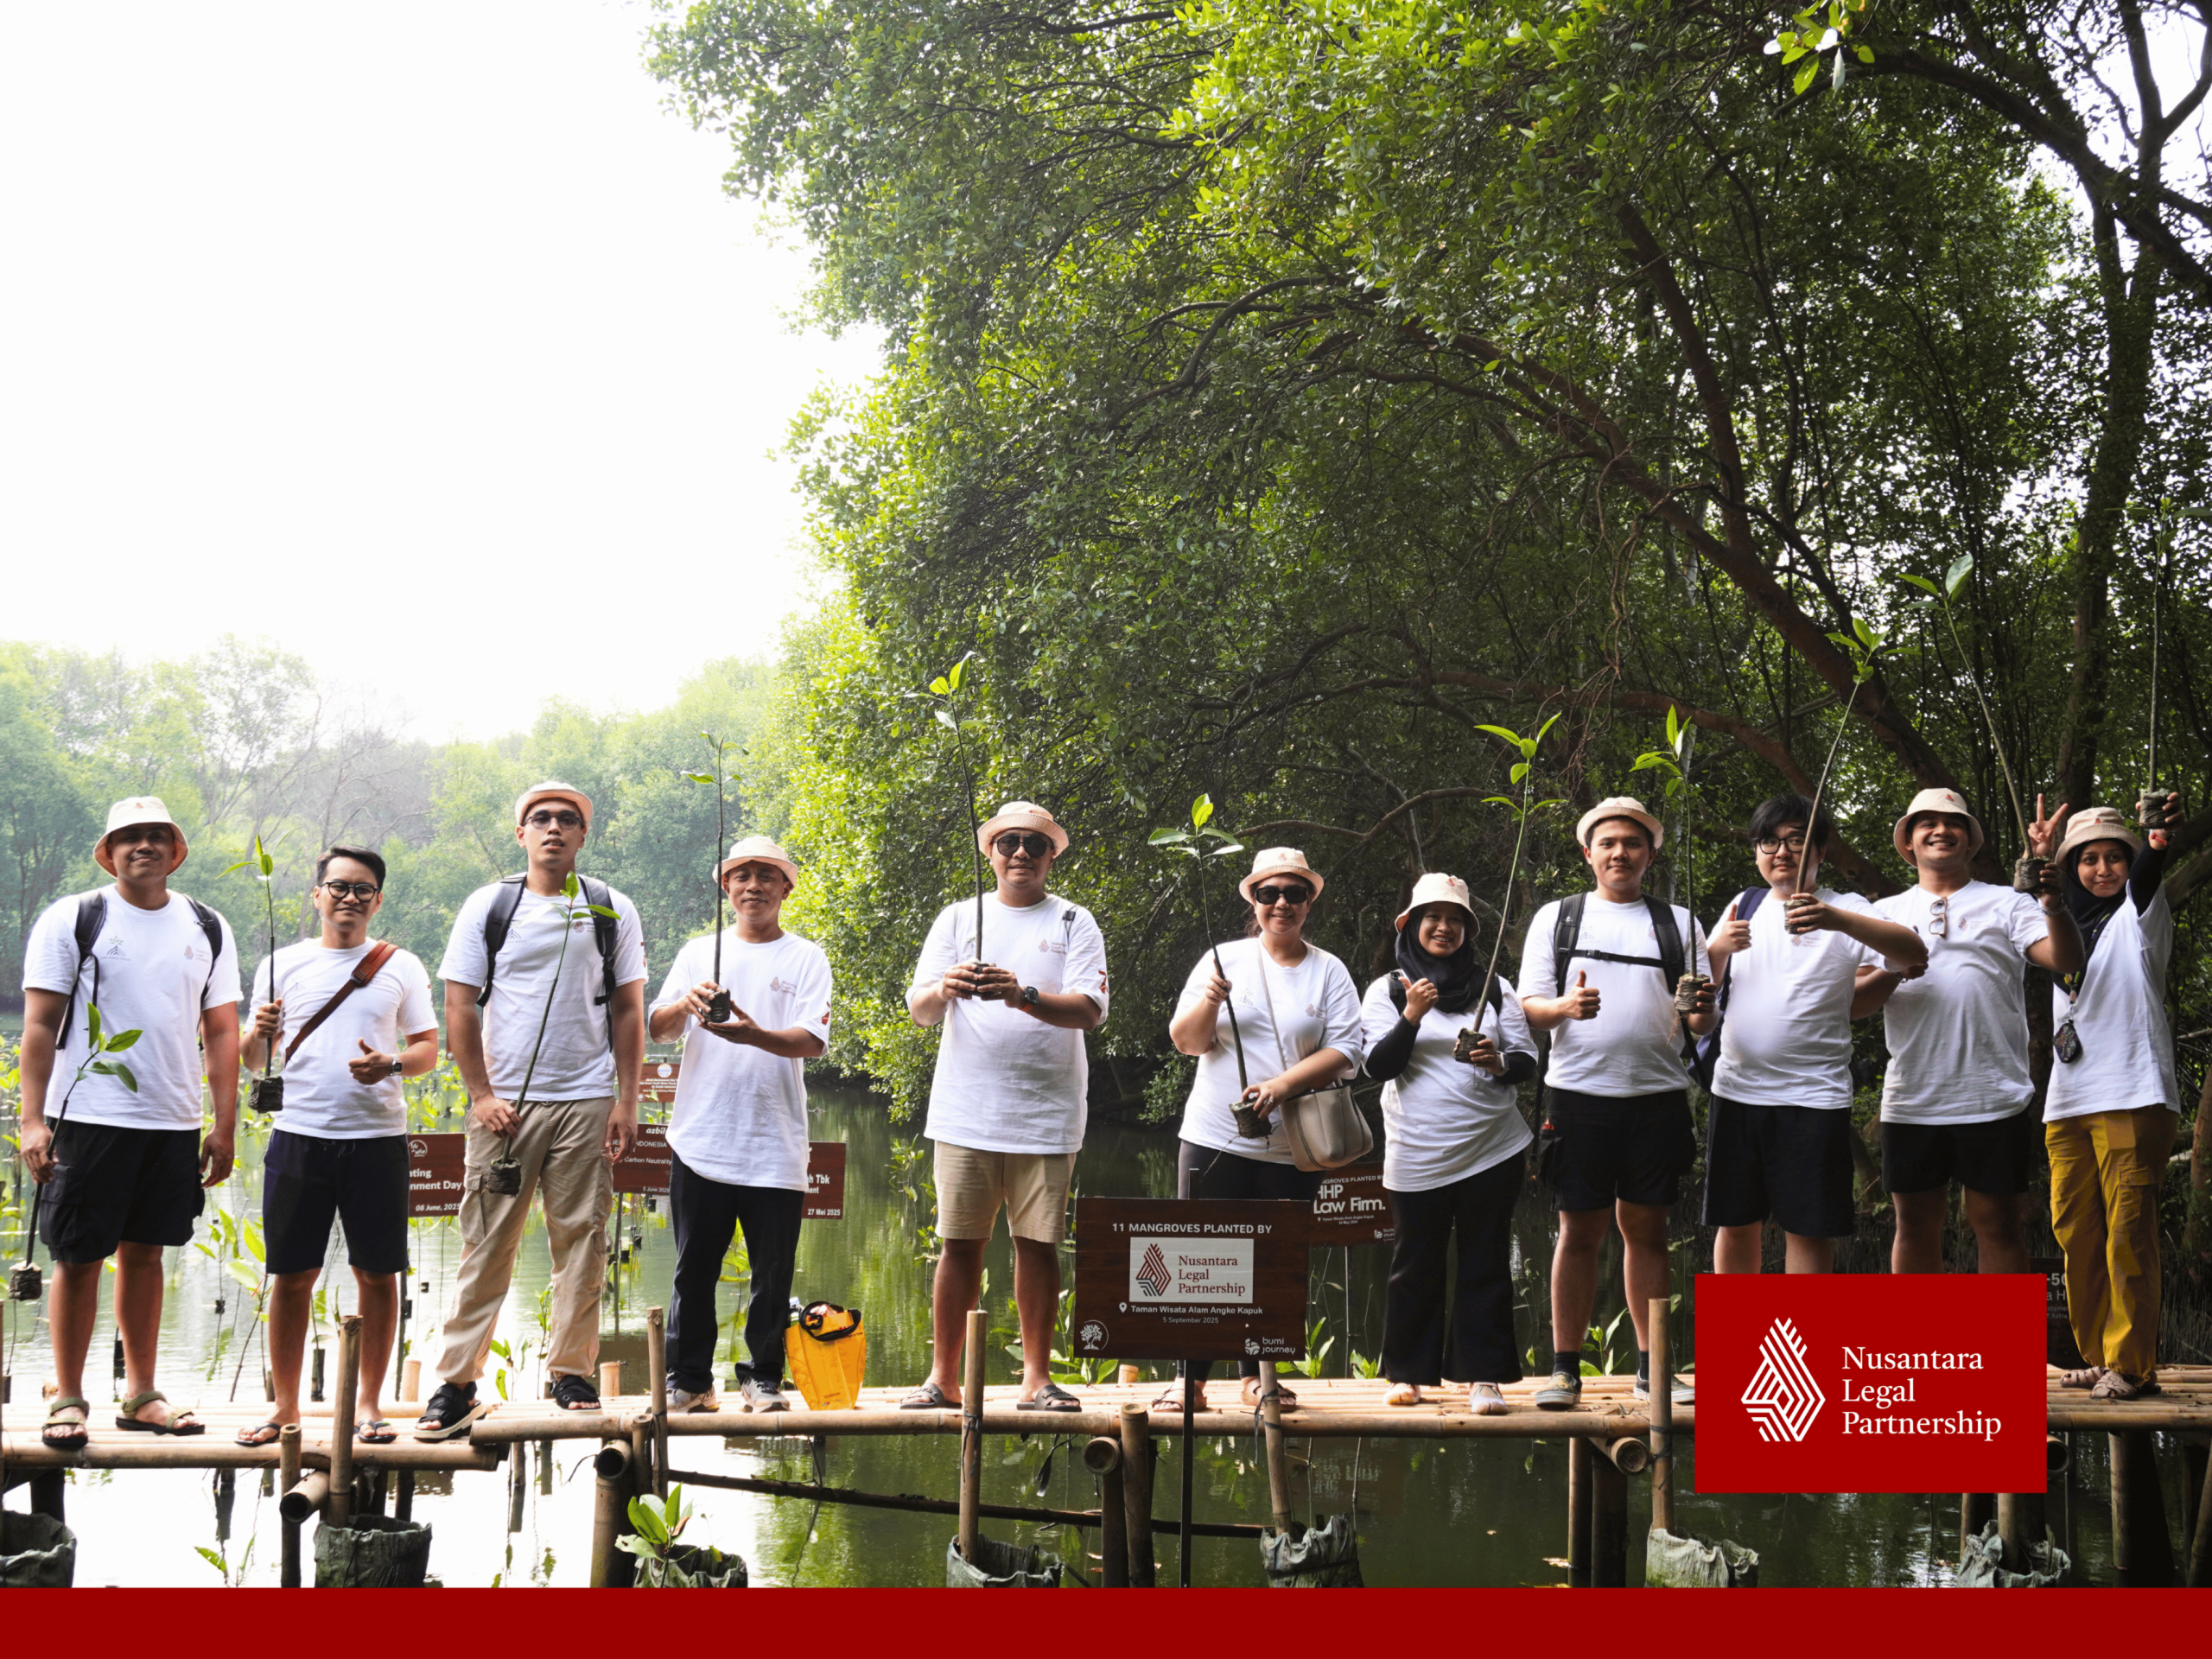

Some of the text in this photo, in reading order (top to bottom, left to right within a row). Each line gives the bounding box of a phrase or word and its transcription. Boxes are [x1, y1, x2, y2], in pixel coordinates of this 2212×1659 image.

[816, 1174, 830, 1185] Tbk
[442, 1180, 462, 1191] Day
[1313, 1197, 1386, 1214] Law Firm.
[1112, 1223, 1273, 1234] 11 MANGROVES PLANTED BY
[1178, 1255, 1238, 1267] Nusantara
[1178, 1268, 1210, 1283] Legal
[1178, 1282, 1246, 1297] Partnership
[1131, 1305, 1158, 1313] Taman
[1210, 1306, 1236, 1316] Angke
[1237, 1306, 1263, 1316] Kapuk
[1168, 1316, 1201, 1325] September
[1262, 1336, 1285, 1345] bumi
[1261, 1346, 1296, 1356] journey
